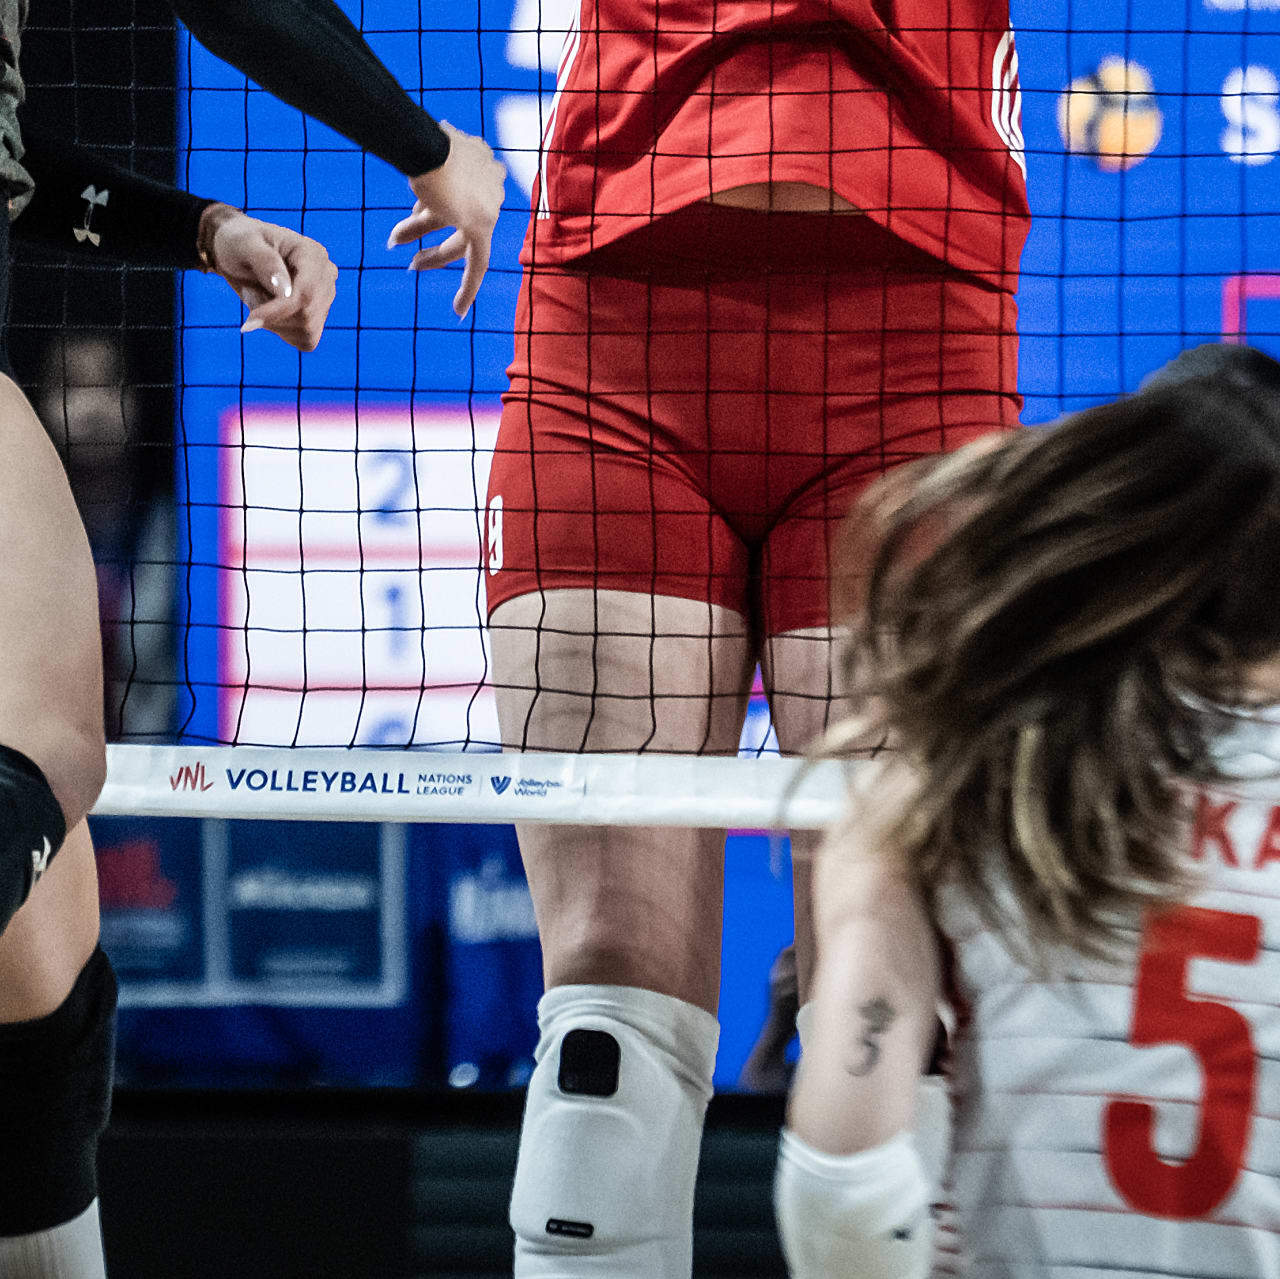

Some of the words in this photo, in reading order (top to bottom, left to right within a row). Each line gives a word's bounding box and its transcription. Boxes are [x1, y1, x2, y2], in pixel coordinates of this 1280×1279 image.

[170, 761, 214, 792] VNL
[226, 768, 410, 795] VOLLEYBALL
[418, 773, 473, 785] NATIONS
[416, 786, 465, 797] LEAGUE
[1100, 904, 1262, 1222] 5
